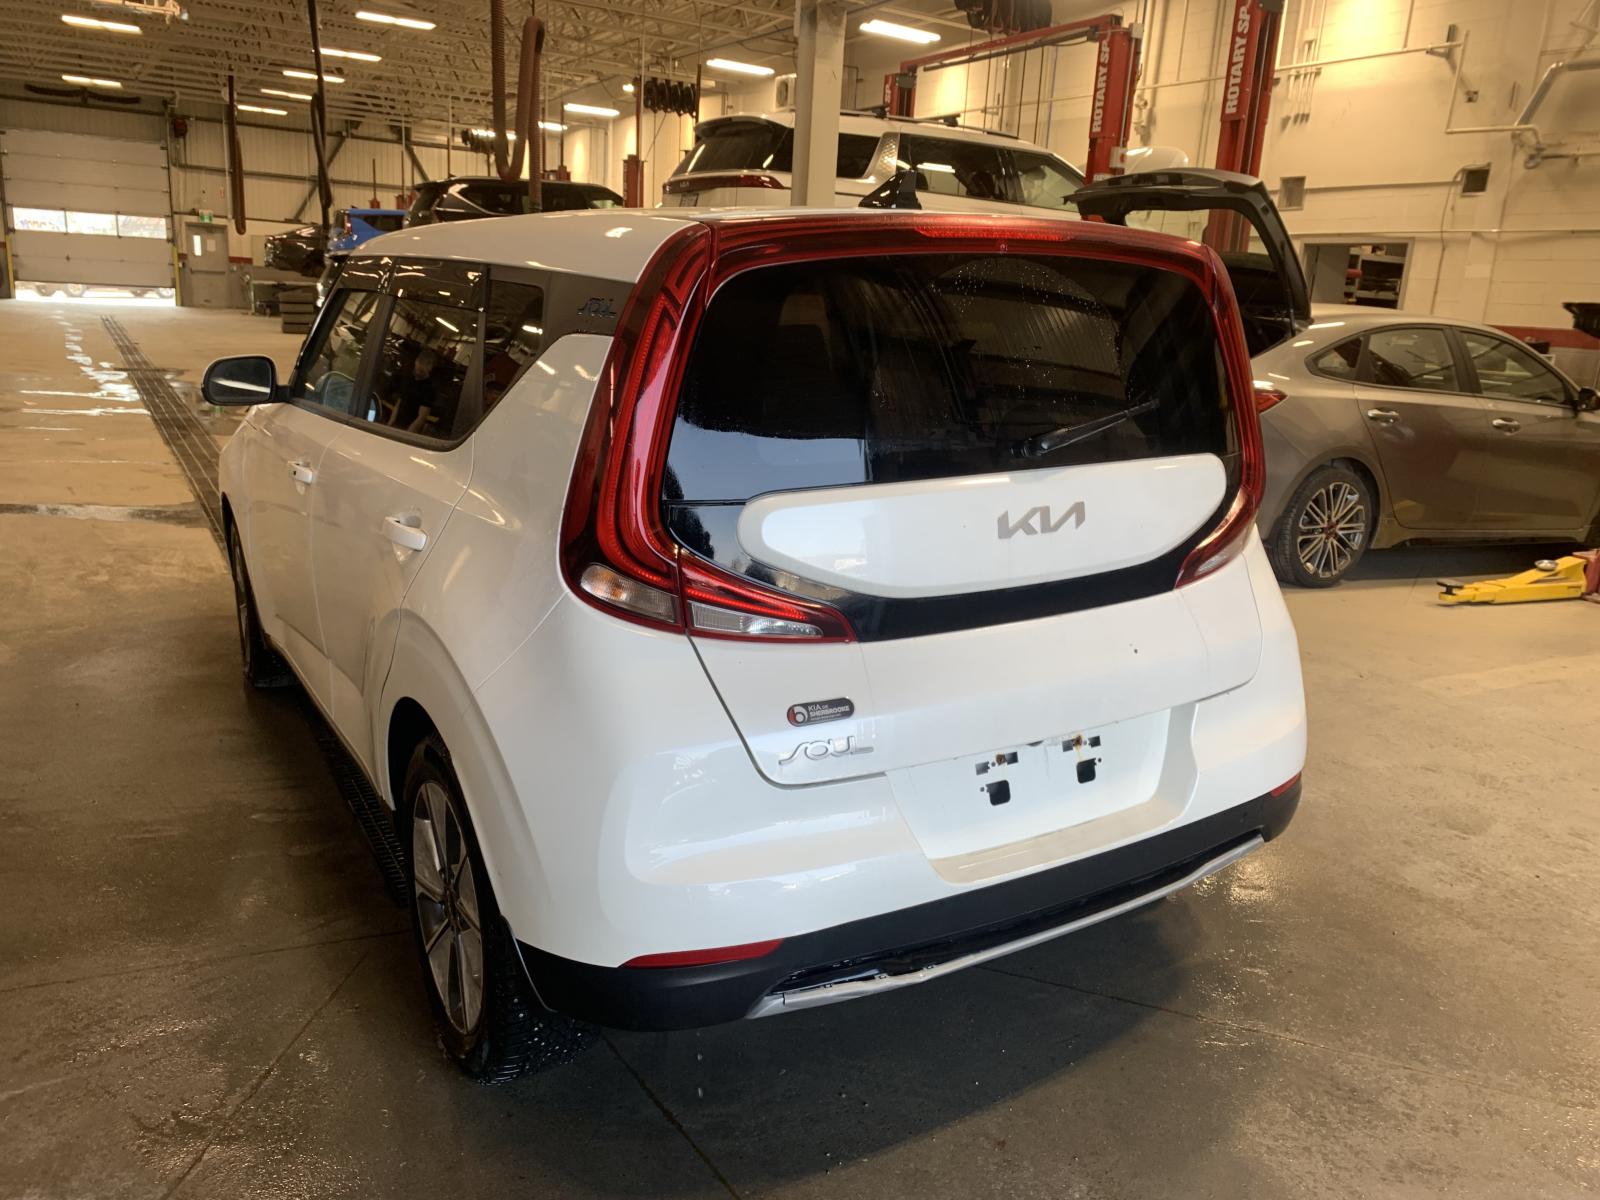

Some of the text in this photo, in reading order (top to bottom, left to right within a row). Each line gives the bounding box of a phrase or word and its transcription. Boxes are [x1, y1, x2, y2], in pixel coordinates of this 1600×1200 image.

[1225, 35, 1247, 114] ROTARY
[1092, 66, 1109, 133] ROTARY
[997, 501, 1085, 539] KIA
[808, 704, 821, 712] KIA
[779, 735, 874, 765] SOUL
